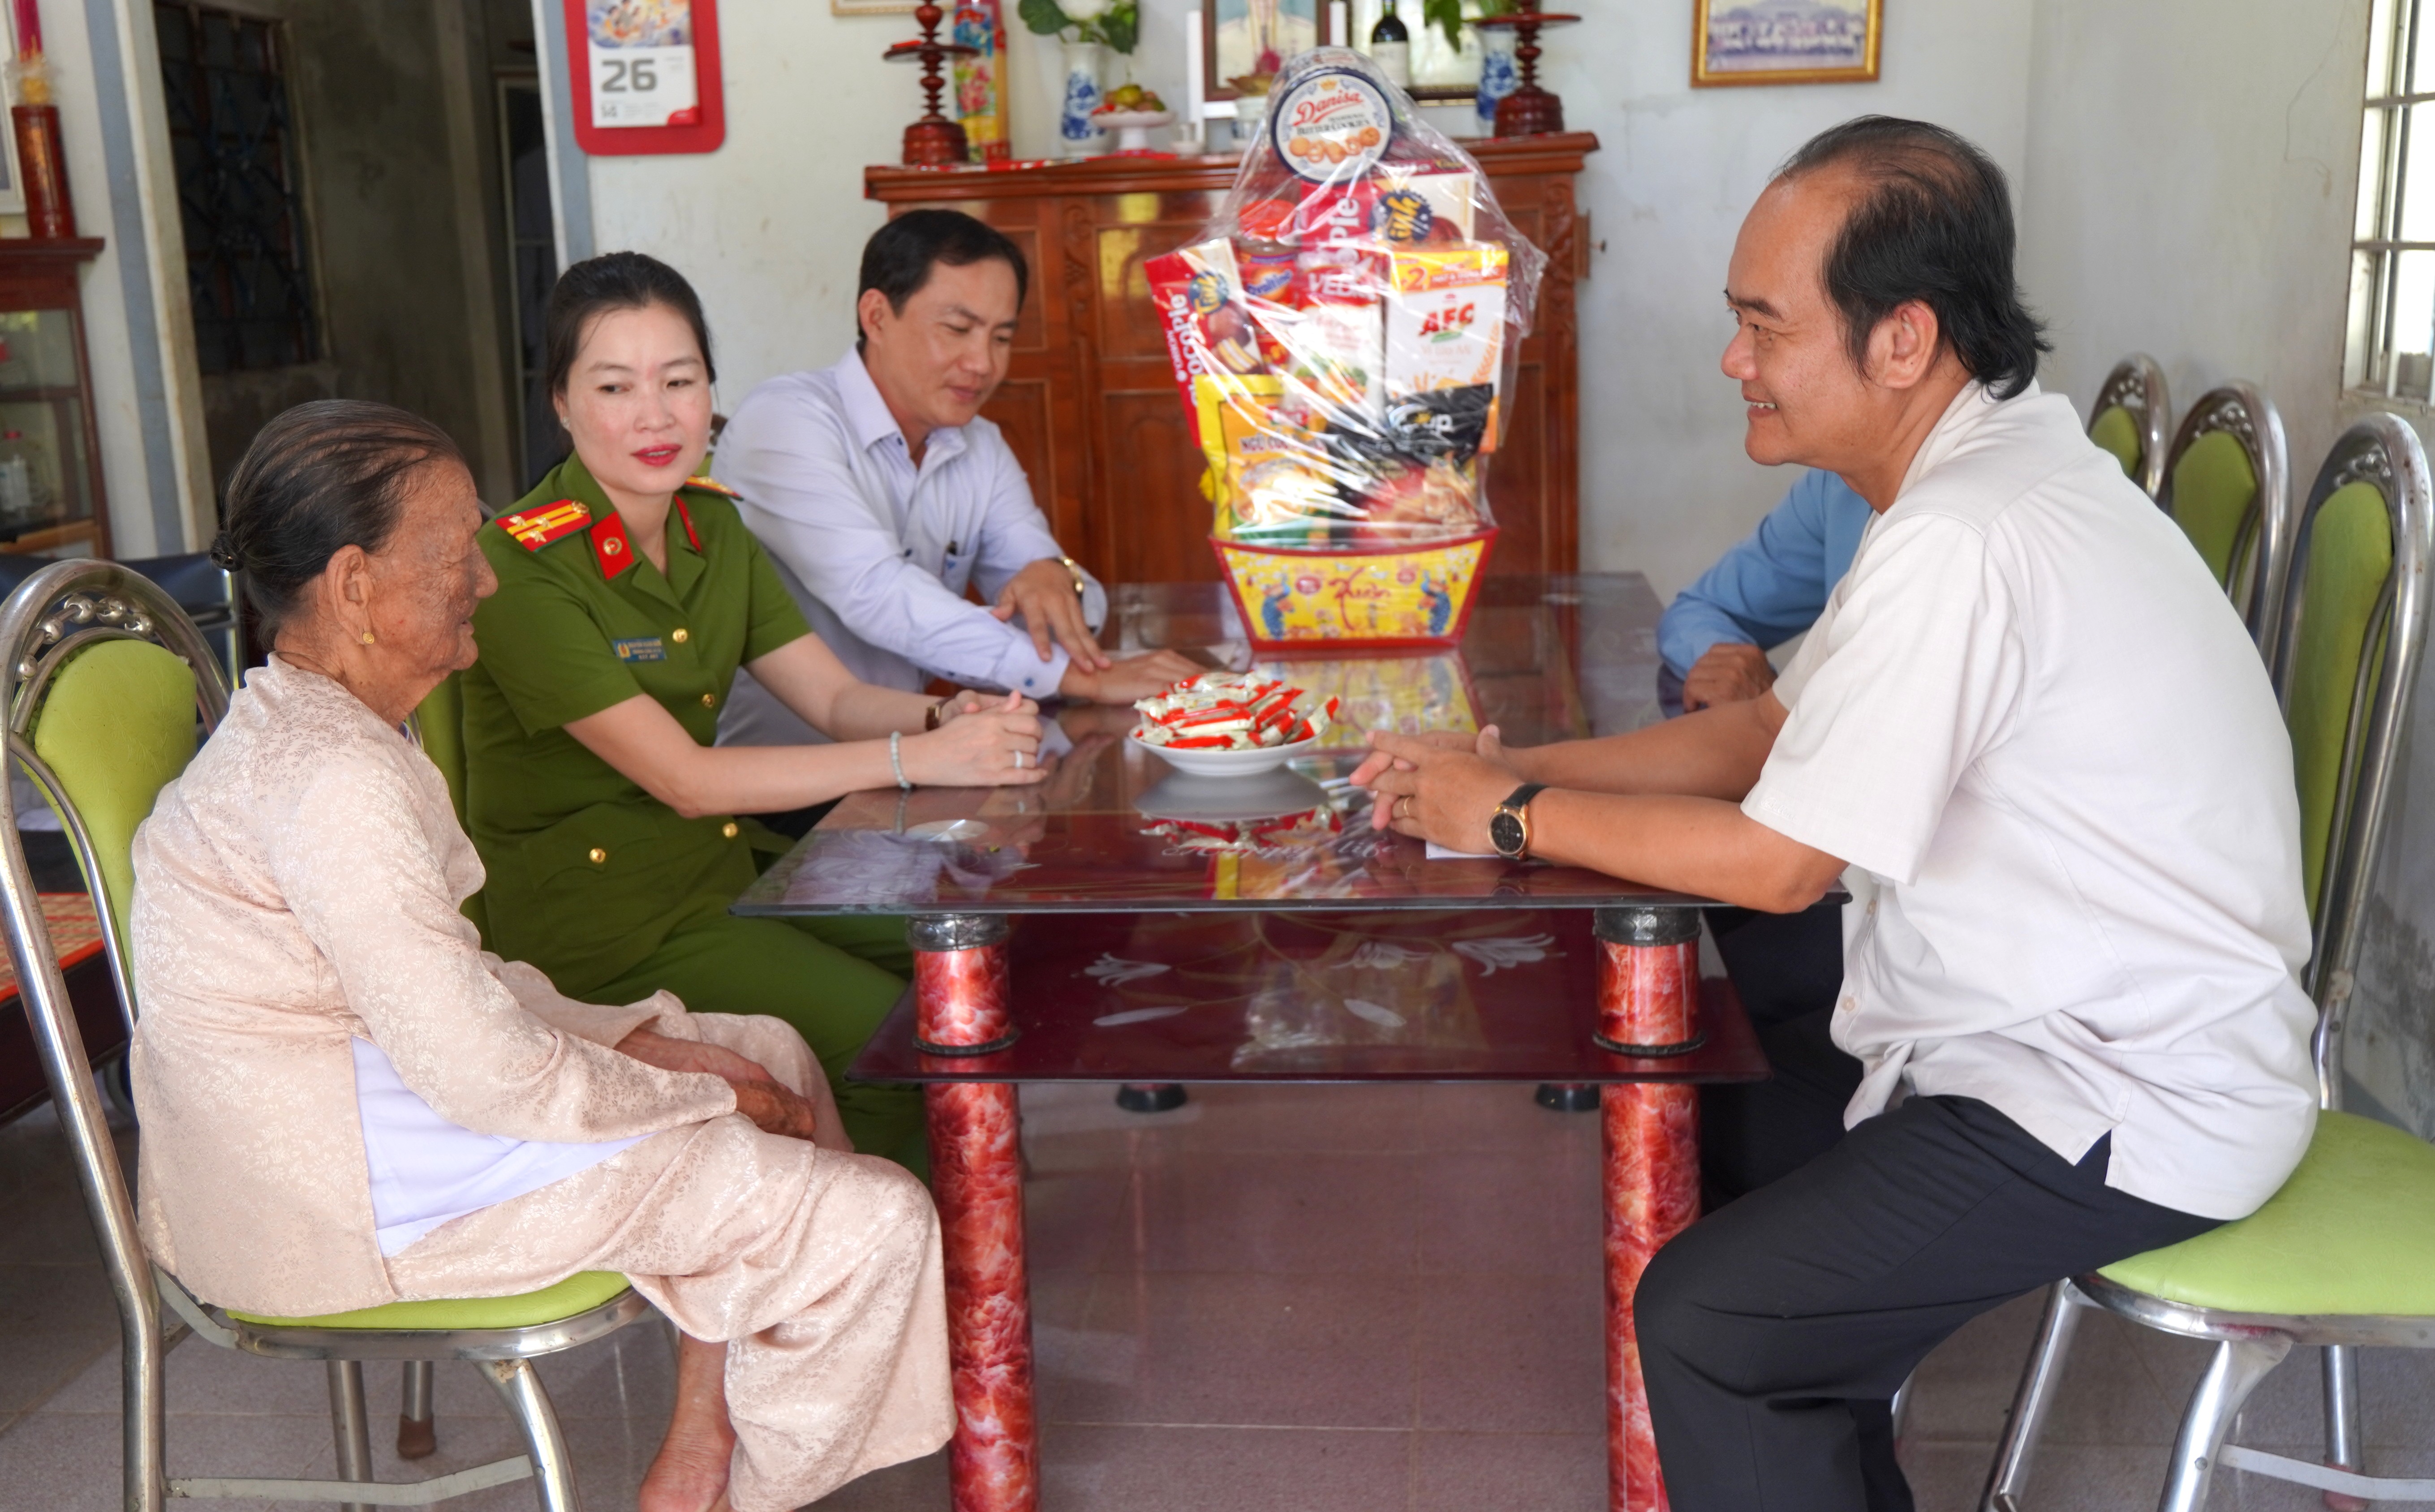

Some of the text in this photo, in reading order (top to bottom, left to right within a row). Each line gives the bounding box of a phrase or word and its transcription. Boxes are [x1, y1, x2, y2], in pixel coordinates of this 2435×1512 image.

[602, 59, 657, 92] 26
[1293, 89, 1365, 127] Danisa
[1419, 303, 1475, 336] AFC
